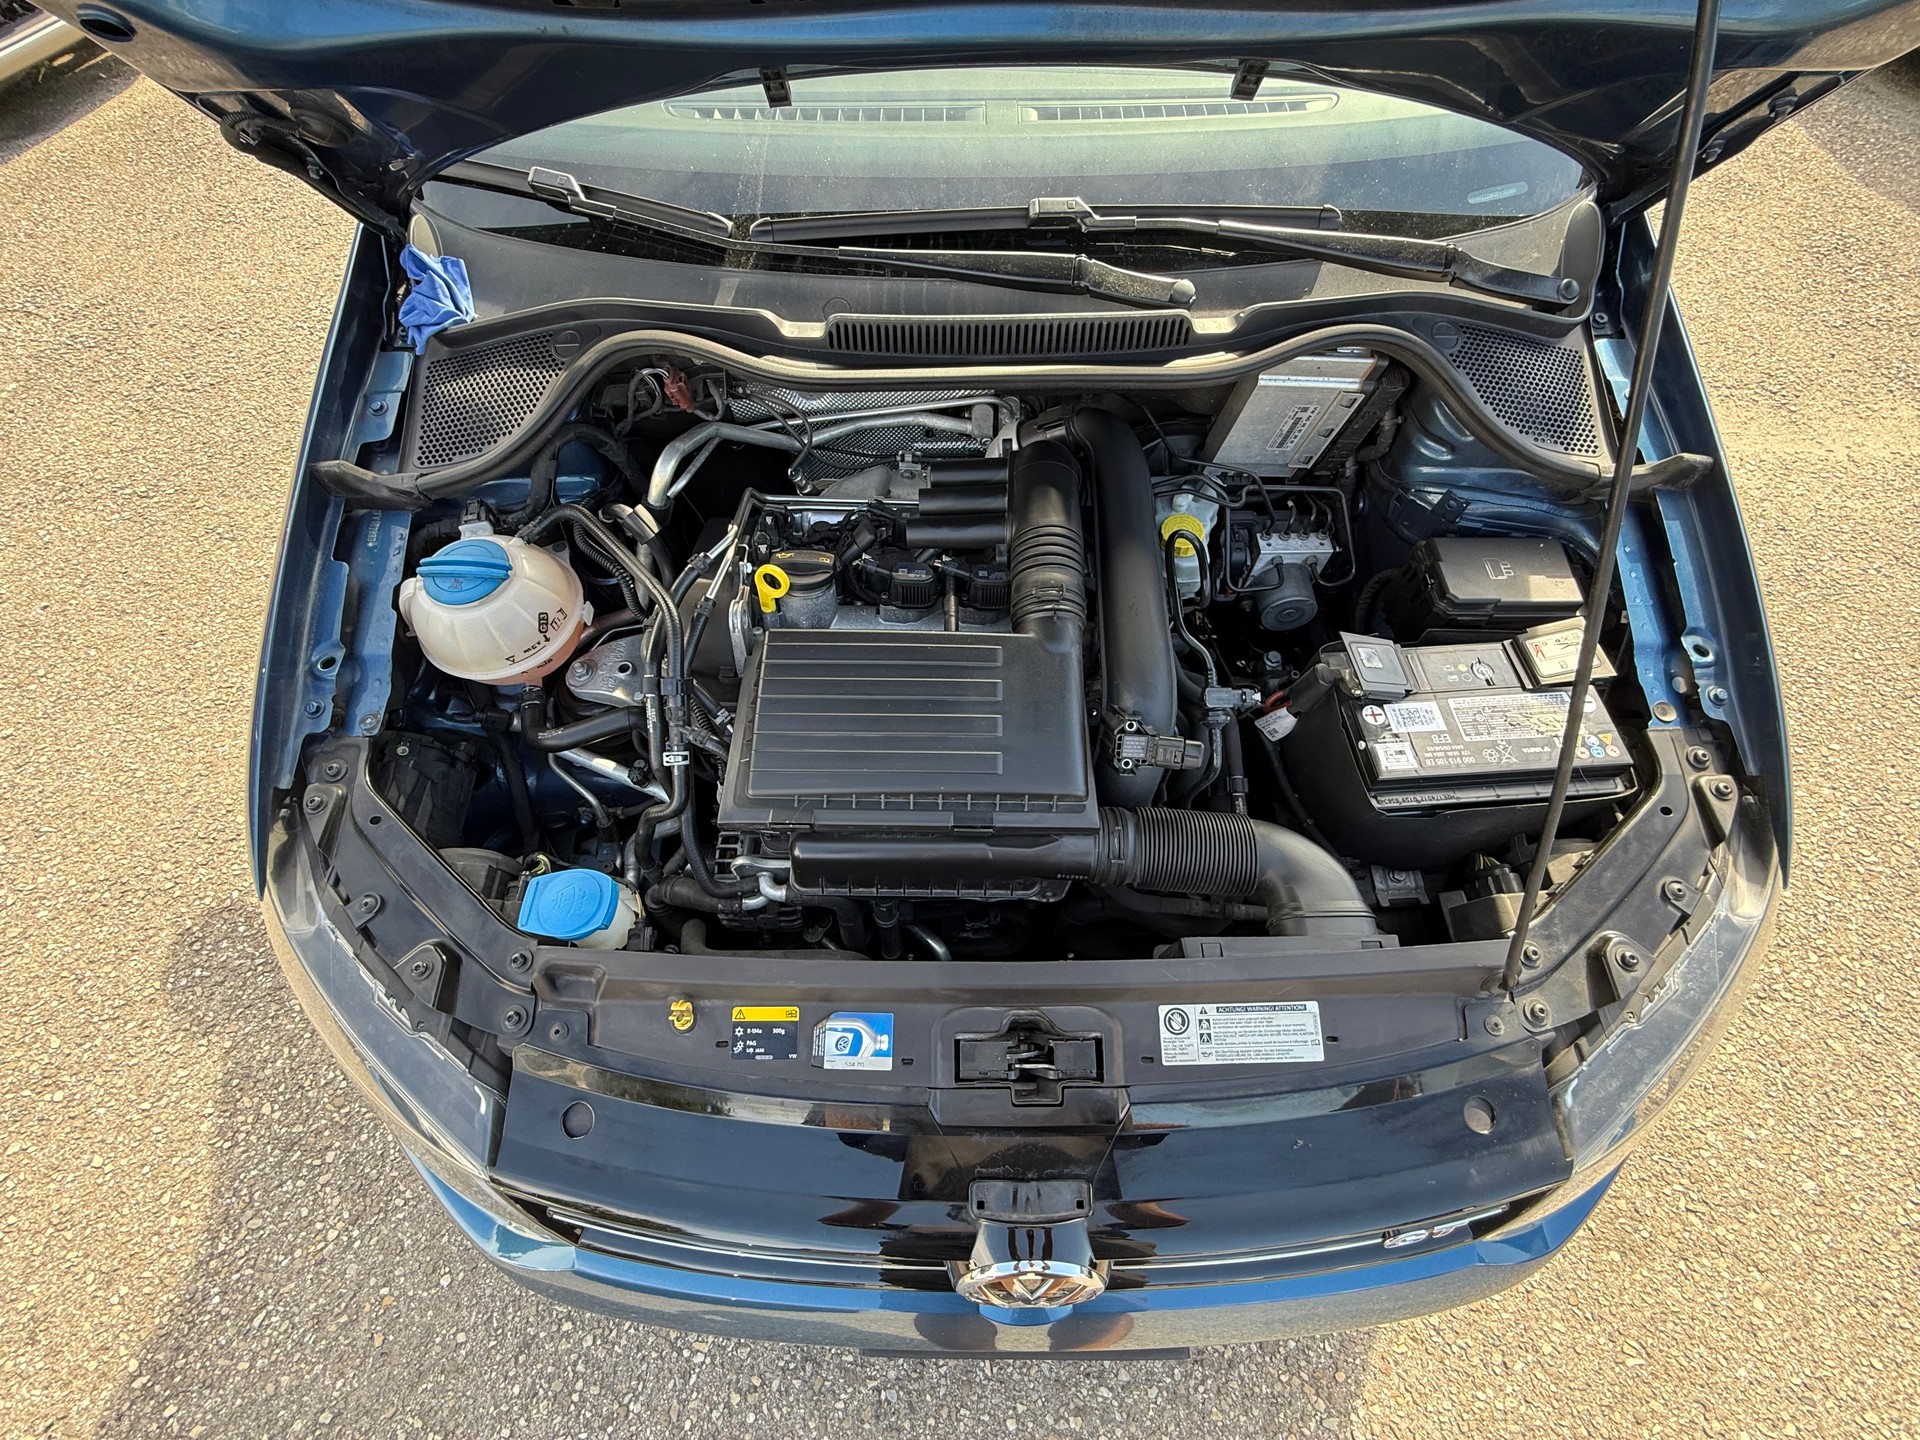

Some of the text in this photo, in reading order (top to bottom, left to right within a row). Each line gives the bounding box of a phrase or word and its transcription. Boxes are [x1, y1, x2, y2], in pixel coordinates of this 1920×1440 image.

[540, 613, 548, 632] G13
[1431, 733, 1452, 744] EFB
[1449, 757, 1462, 765] 915
[1462, 756, 1475, 764] 000
[772, 1027, 786, 1035] 500g
